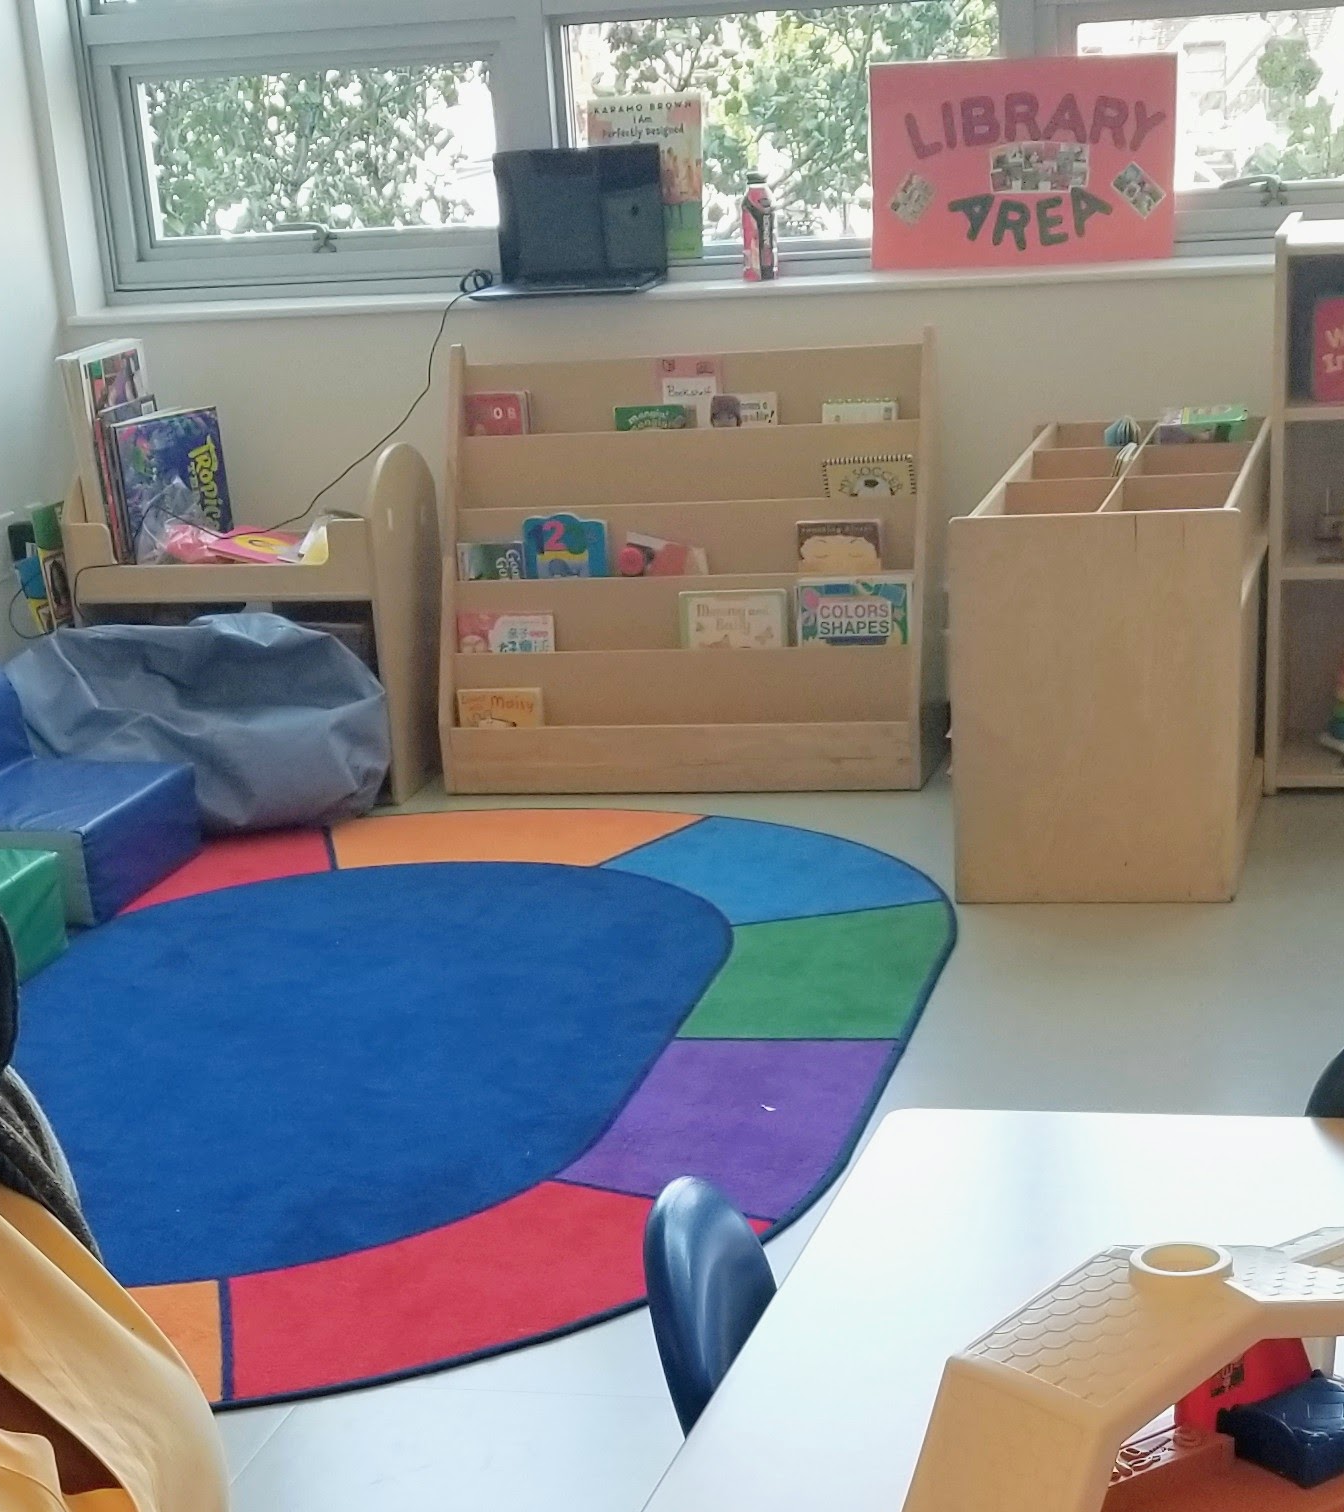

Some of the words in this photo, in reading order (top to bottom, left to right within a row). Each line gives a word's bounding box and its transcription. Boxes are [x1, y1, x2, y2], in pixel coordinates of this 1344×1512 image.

[593, 103, 643, 114] KARAMO
[649, 101, 692, 111] BROWN
[638, 115, 653, 124] Am
[905, 91, 1166, 160] LIBRARY
[947, 186, 1113, 251] AREA
[852, 466, 904, 493] SOCCER
[819, 604, 889, 619] COLORS
[819, 620, 890, 636] SHAPES
